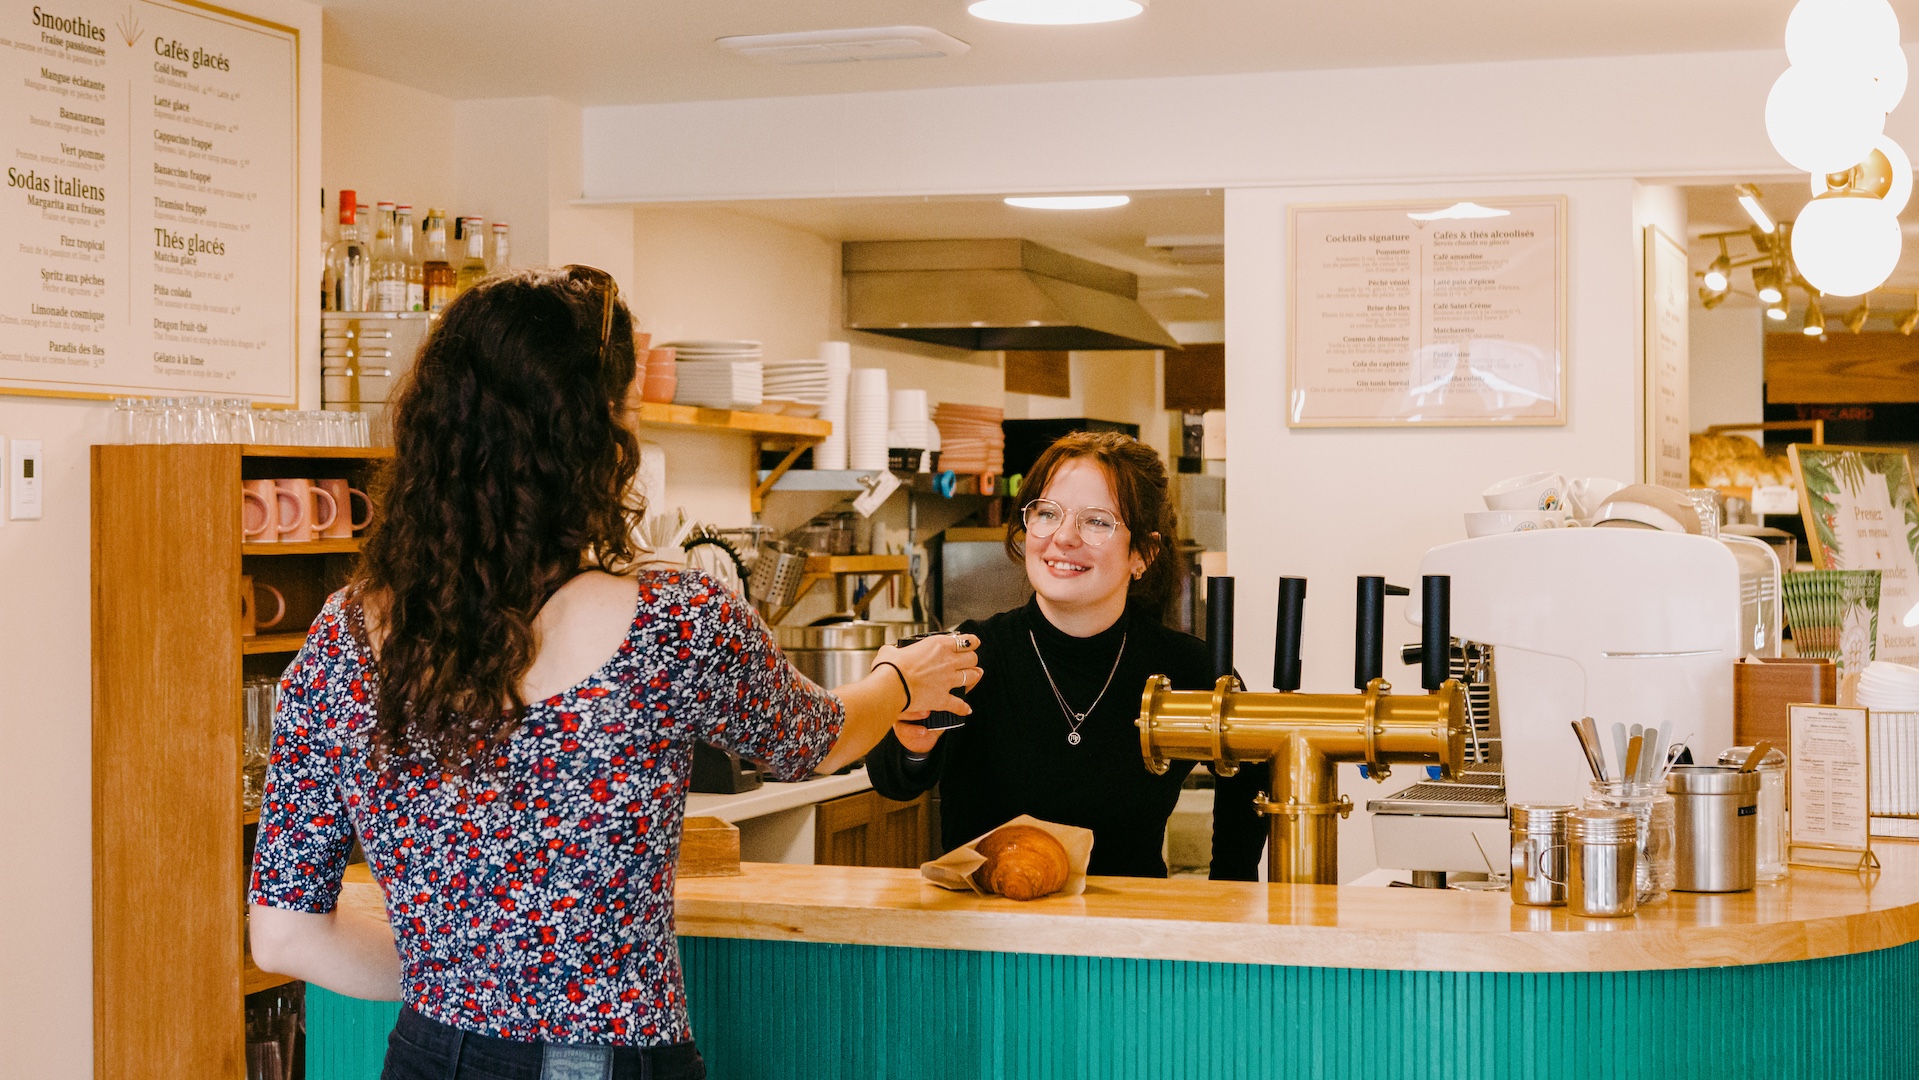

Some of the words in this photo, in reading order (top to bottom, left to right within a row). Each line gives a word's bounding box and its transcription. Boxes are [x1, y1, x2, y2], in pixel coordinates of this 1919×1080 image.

[33, 6, 106, 42] Smoothies
[41, 32, 64, 46] Fraise
[66, 41, 105, 56] passionnée
[155, 37, 190, 62] Cafés
[192, 47, 230, 72] glacés
[154, 61, 170, 74] Cold
[171, 65, 188, 78] brew
[41, 68, 70, 84] Mangue
[72, 74, 105, 91] éclatante
[60, 107, 105, 126] Bananarama
[61, 143, 77, 155] Vert
[79, 149, 105, 161] pomme
[191, 136, 213, 152] frappé
[154, 163, 189, 178] Banaccino
[190, 169, 212, 183] frappé
[8, 167, 50, 192] Sodas
[54, 174, 105, 201] italiens
[27, 195, 65, 210] Margarita
[66, 203, 79, 212] aux
[81, 202, 105, 216] fraises
[154, 196, 184, 211] Tiramisu
[185, 201, 207, 216] frappé
[154, 228, 185, 250] Thés
[188, 233, 225, 256] glacés
[1325, 234, 1367, 243] Cocktails
[1369, 234, 1410, 243] signature
[1433, 231, 1458, 239] Cafés
[1460, 231, 1467, 239] &
[1470, 230, 1489, 239] thés
[1491, 229, 1535, 238] alcoolisés
[60, 235, 76, 247] Fizz
[77, 238, 105, 251] tropical
[154, 251, 179, 263] Matcha
[180, 254, 198, 266] glacé
[41, 269, 63, 282] Spritz
[65, 274, 78, 283] aux
[80, 273, 105, 286] pêches
[154, 284, 169, 295] Piña
[170, 287, 192, 298] colada
[31, 303, 69, 317] Limonade
[70, 309, 105, 322] cosmique
[154, 318, 179, 332] Dragon
[180, 320, 208, 333] fruit-thé
[49, 341, 77, 353] Paradis
[78, 344, 91, 354] des
[154, 352, 176, 363] Gélato
[177, 353, 181, 364] à
[183, 354, 189, 364] la
[190, 354, 204, 365] lime
[1379, 360, 1410, 368] capitaine
[1854, 507, 1884, 521] Prenez
[1857, 528, 1867, 538] un
[1883, 634, 1916, 649] Recevez
